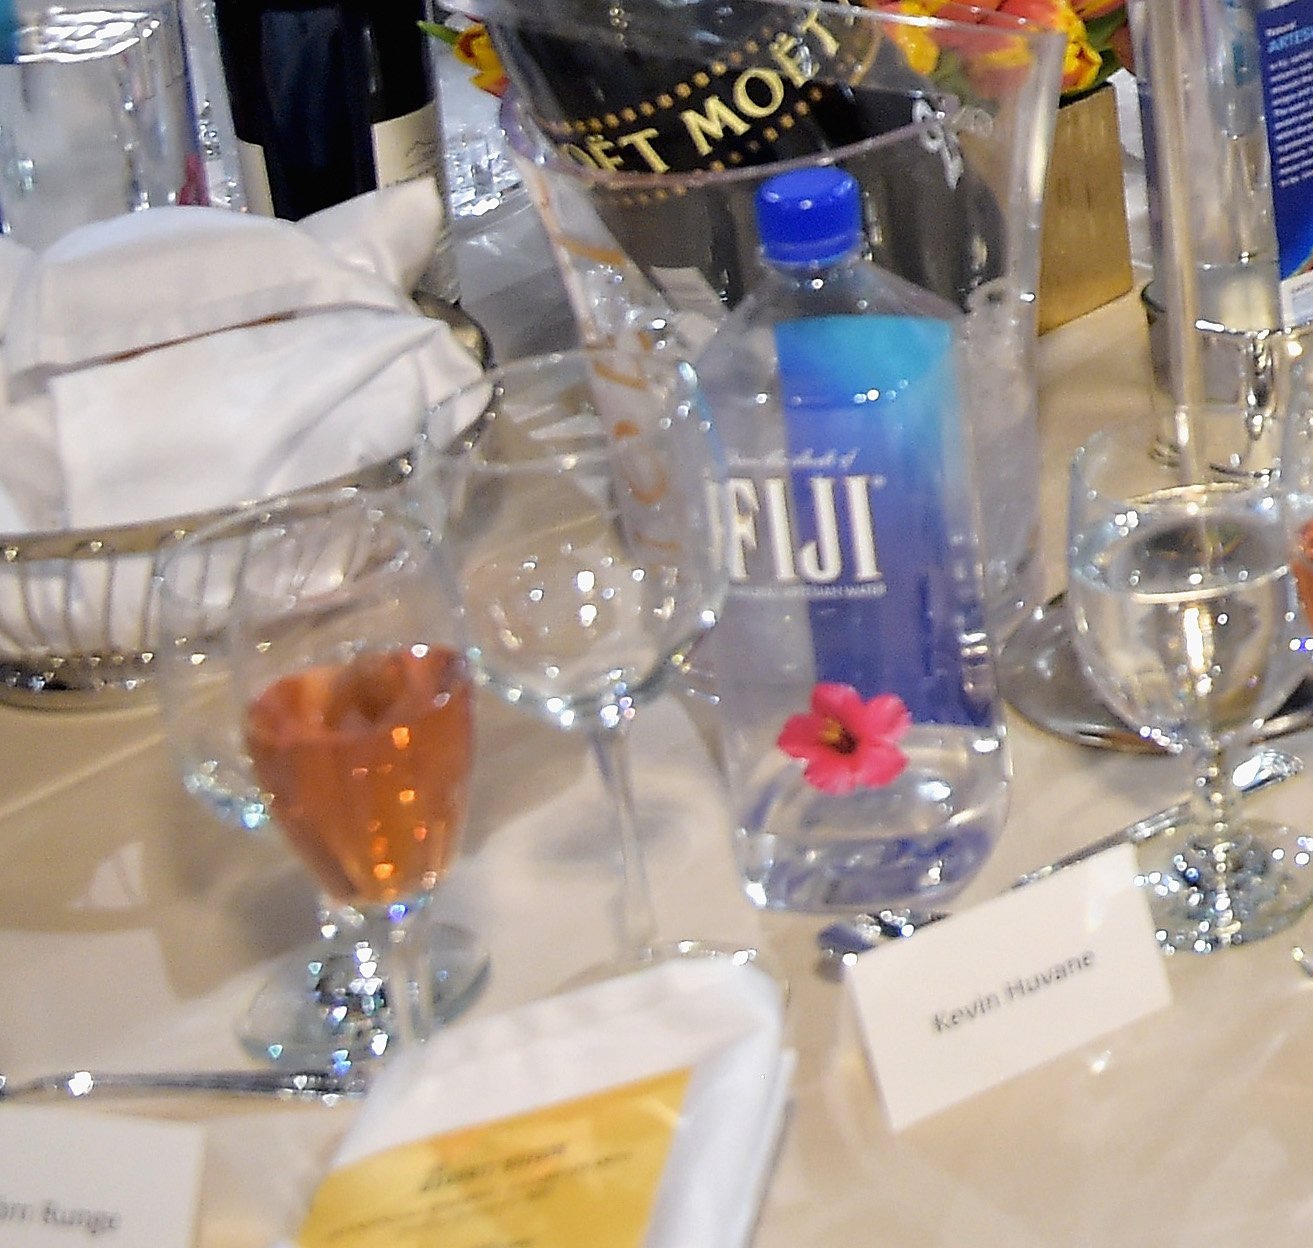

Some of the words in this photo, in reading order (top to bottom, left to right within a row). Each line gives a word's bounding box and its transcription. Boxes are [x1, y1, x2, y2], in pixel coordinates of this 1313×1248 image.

[557, 127, 671, 174] OËT
[680, 5, 841, 157] MOËT
[726, 474, 883, 583] FIJI
[932, 991, 1001, 1035] Kevin
[1003, 949, 1097, 1001] Huvane
